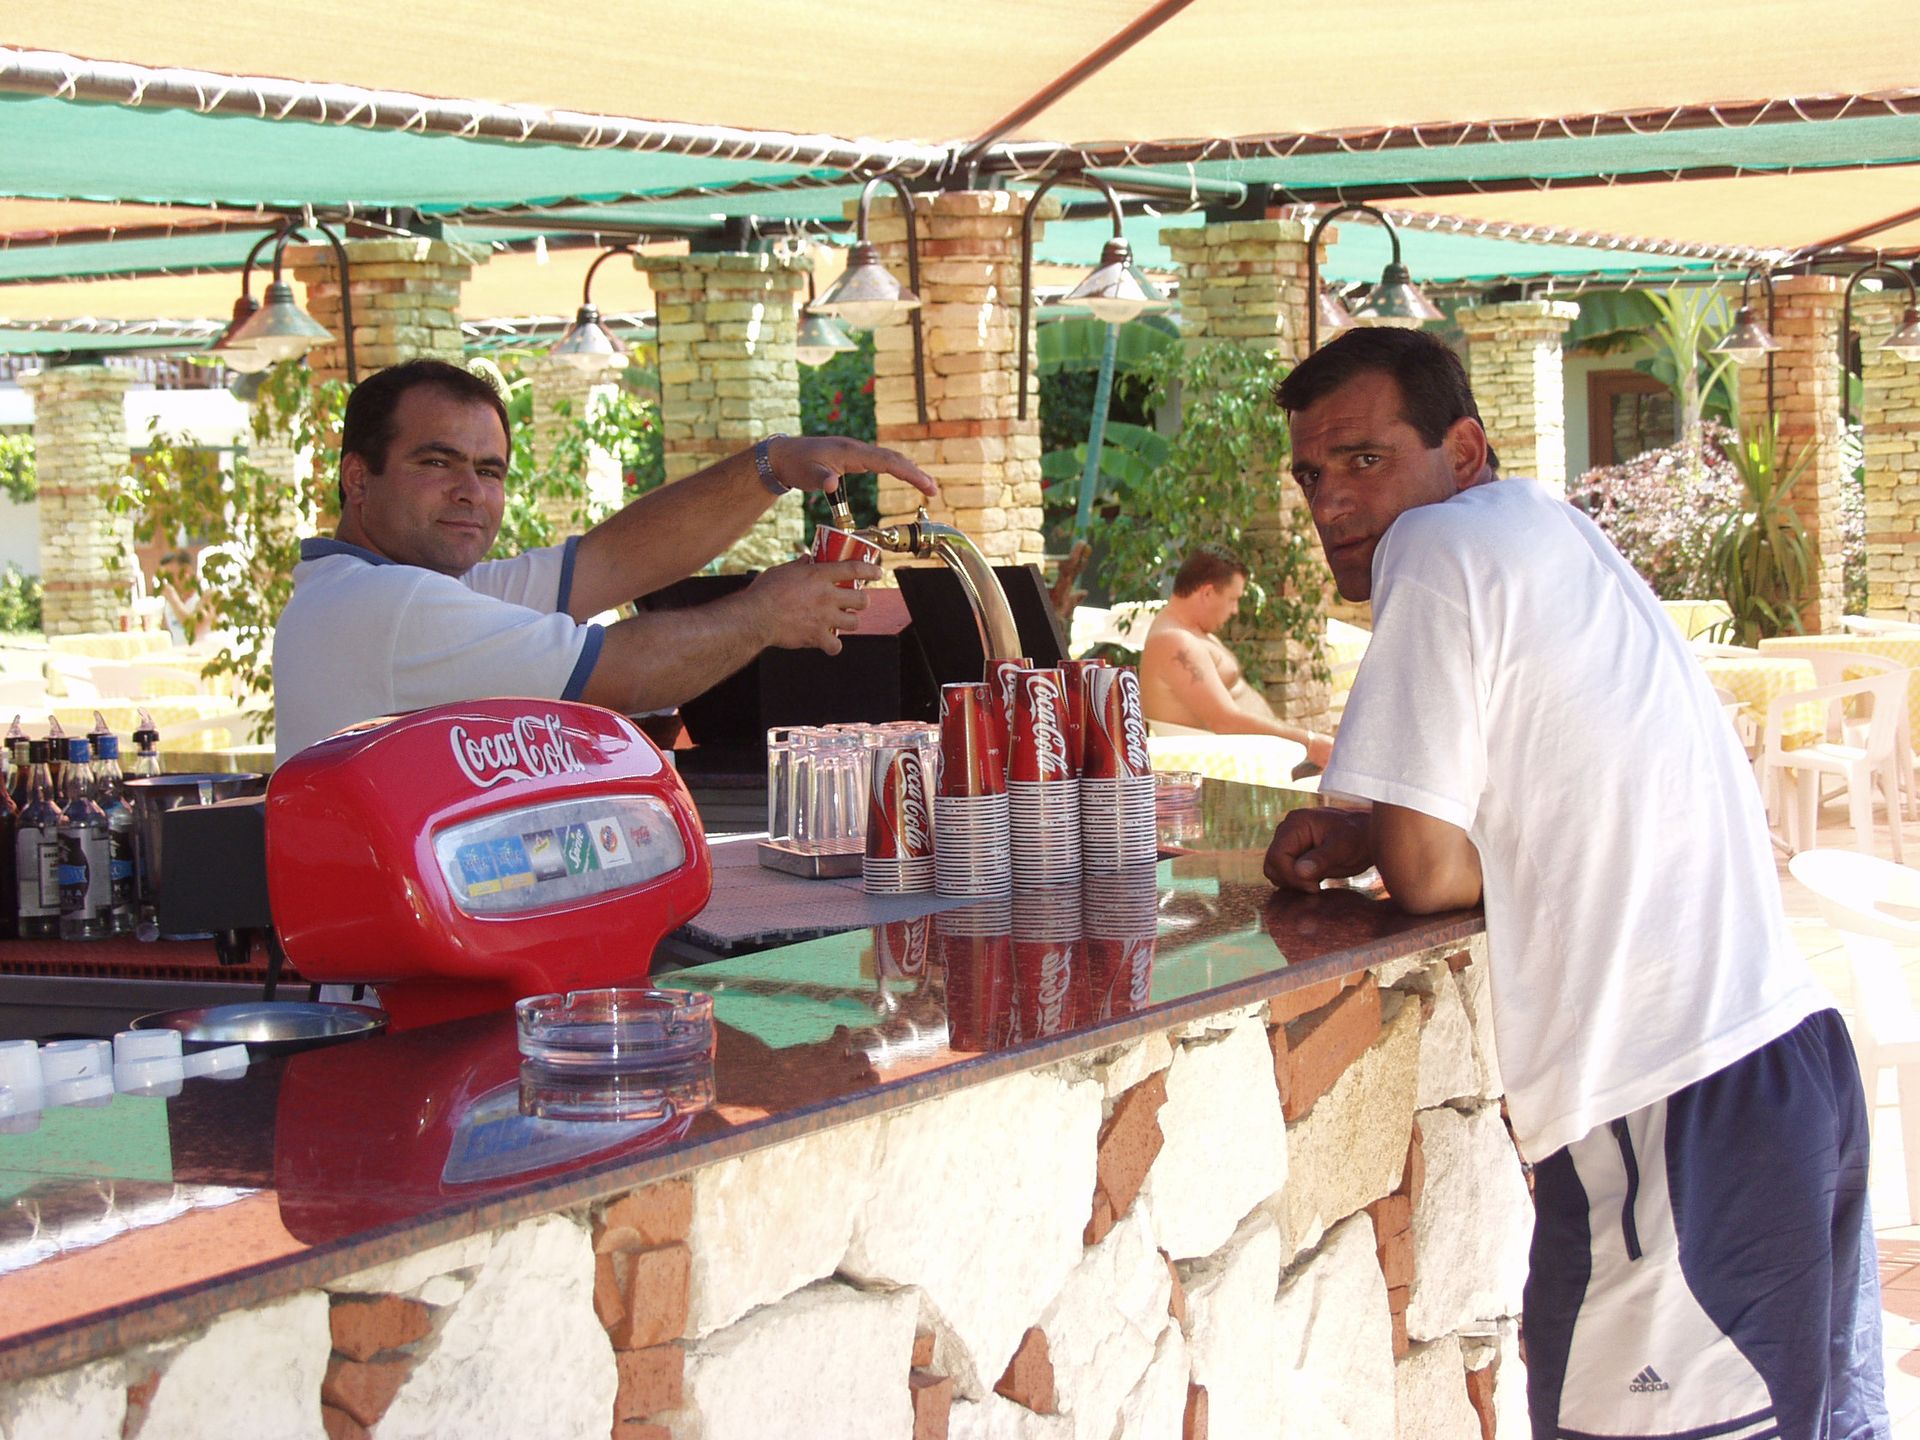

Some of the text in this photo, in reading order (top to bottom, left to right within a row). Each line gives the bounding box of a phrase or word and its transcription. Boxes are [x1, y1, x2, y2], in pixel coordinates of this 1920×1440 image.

[450, 714, 585, 788] Coca-Cola
[1026, 675, 1069, 777] Coca-Cola
[1629, 1381, 1669, 1393] adidas
